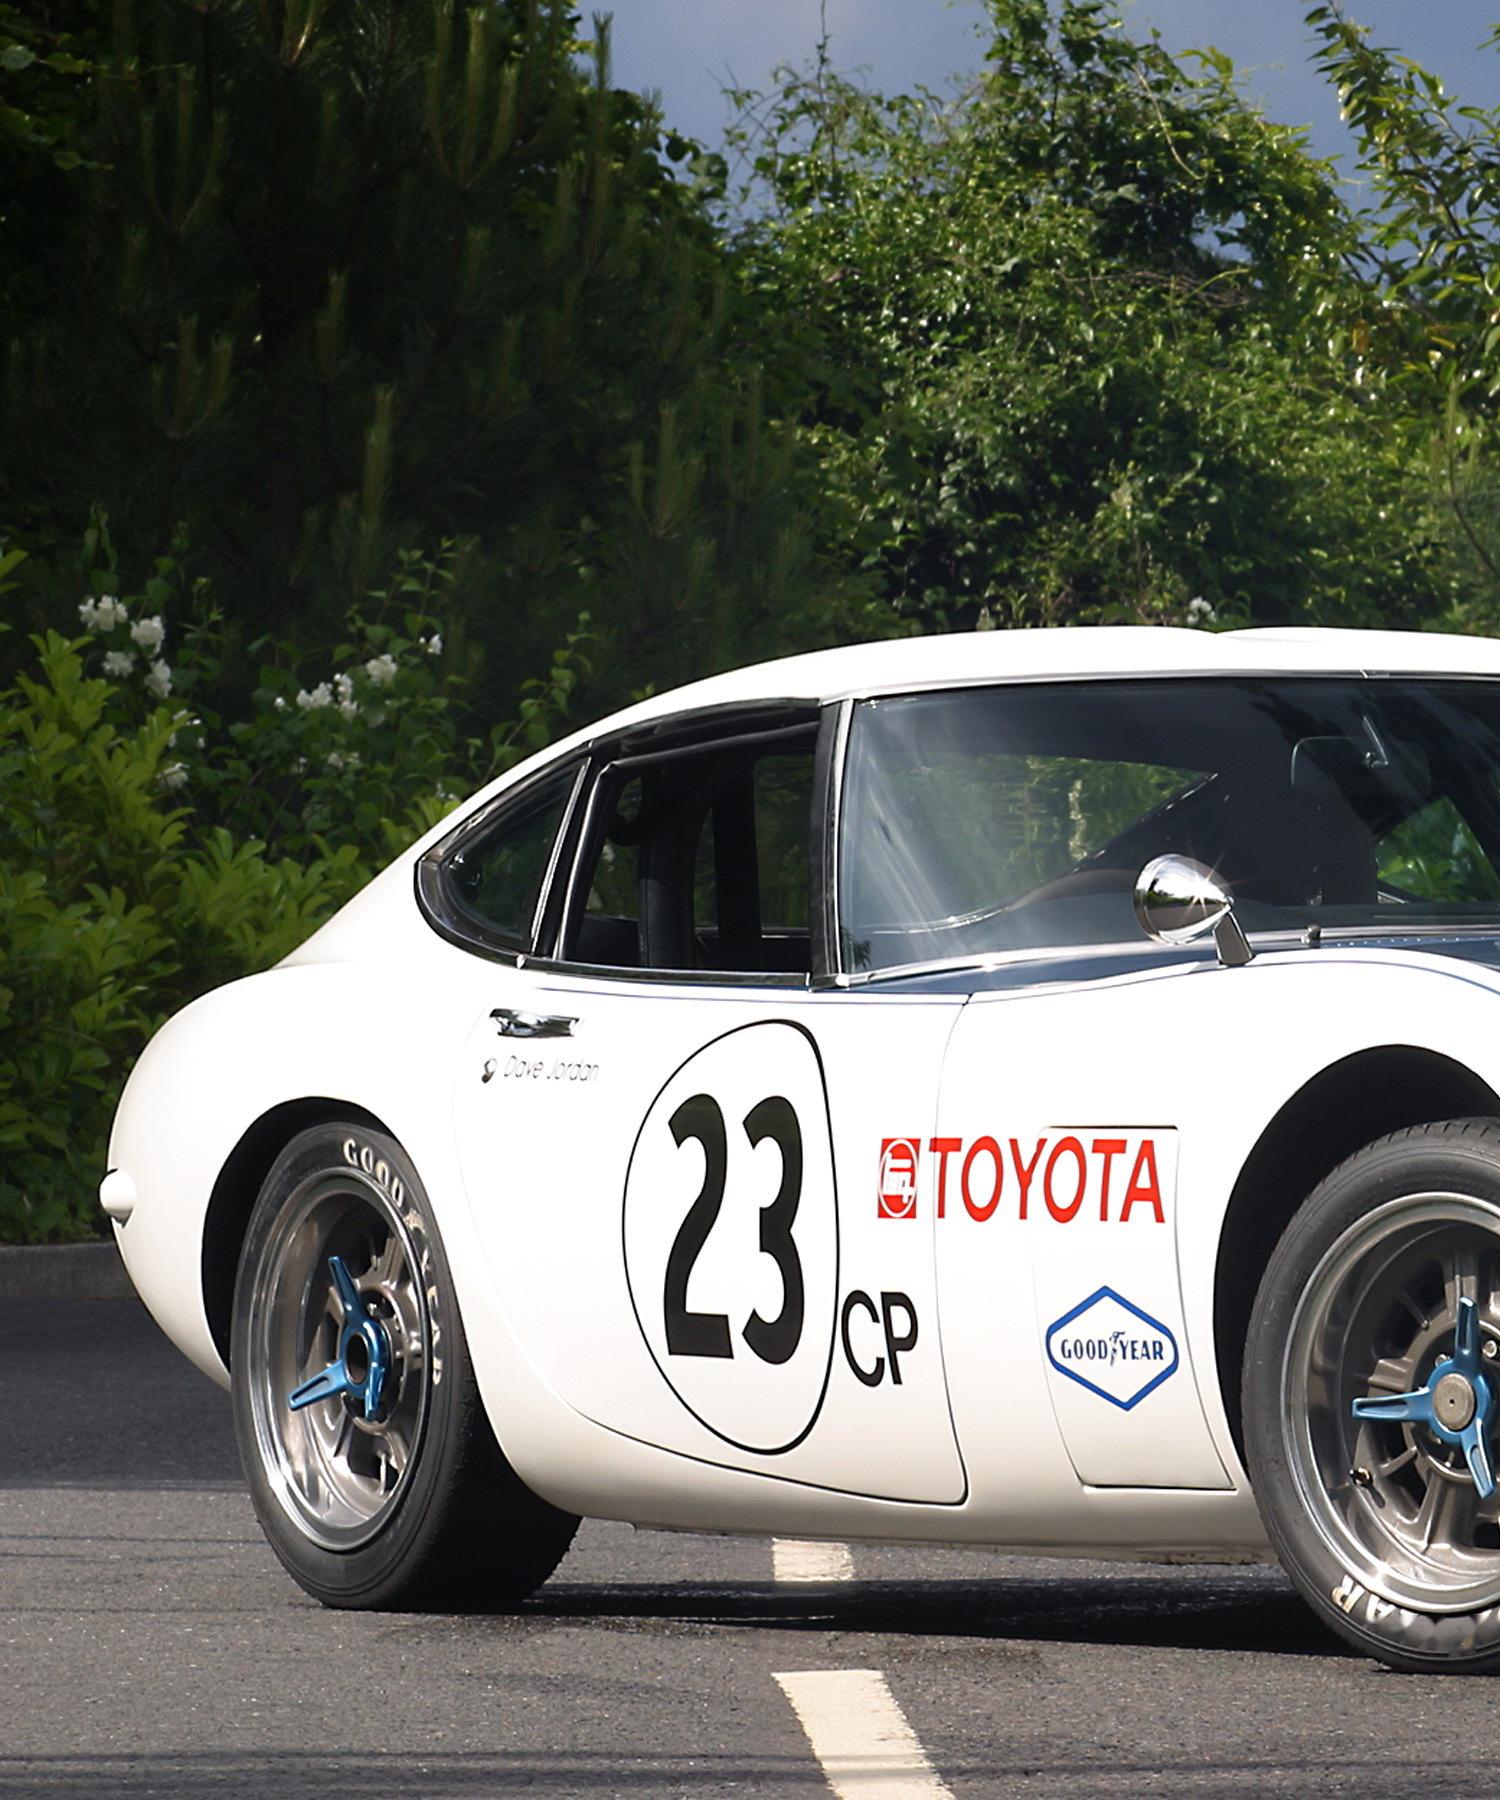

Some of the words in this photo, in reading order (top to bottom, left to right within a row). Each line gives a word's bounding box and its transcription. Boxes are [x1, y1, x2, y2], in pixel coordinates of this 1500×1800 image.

[503, 1054, 544, 1080] Dave
[546, 1056, 601, 1083] Jordan
[343, 1138, 405, 1208] GOOD
[928, 1136, 1165, 1223] TOYOTA
[663, 1093, 805, 1365] 23
[841, 1289, 919, 1388] CP
